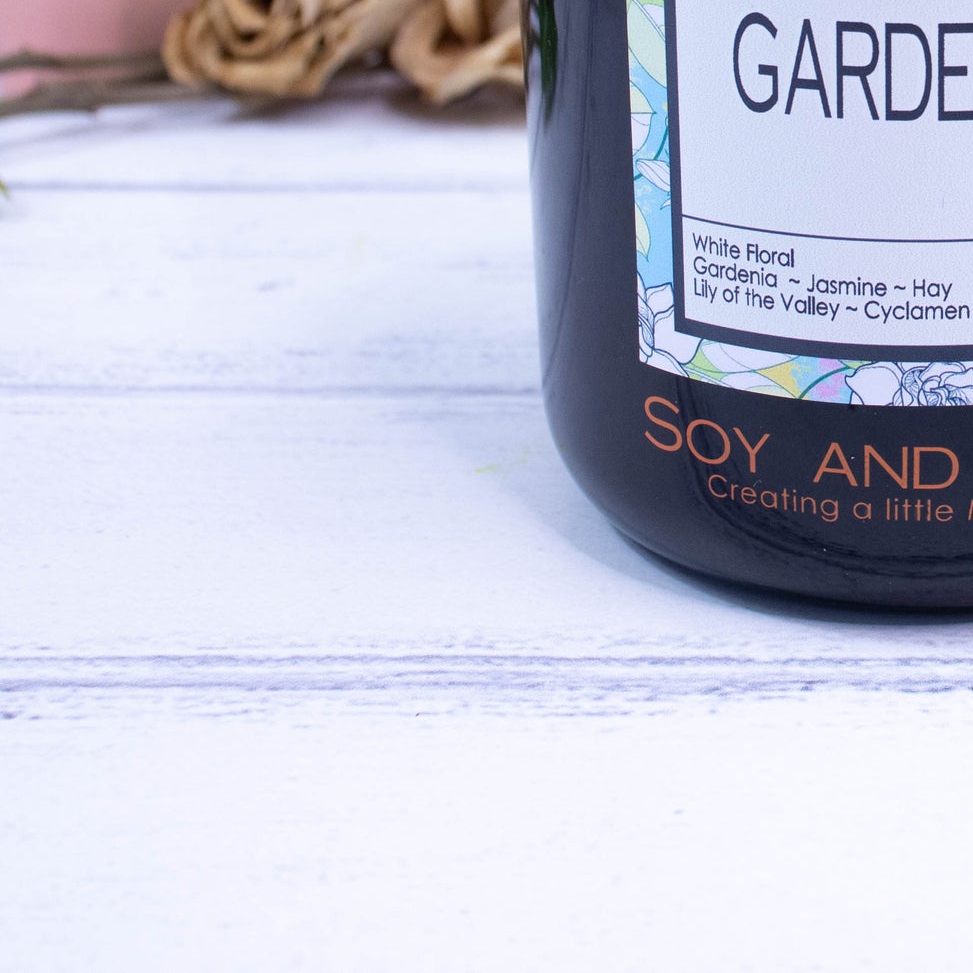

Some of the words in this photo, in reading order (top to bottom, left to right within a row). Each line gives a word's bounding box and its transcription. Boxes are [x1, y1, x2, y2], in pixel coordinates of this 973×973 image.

[692, 232, 741, 260] White
[746, 243, 795, 268] Floral
[693, 256, 778, 288] Gardenia
[806, 274, 888, 297] Jasmine
[912, 278, 953, 302] Hay
[693, 277, 718, 304] Lily
[722, 285, 741, 305] of
[744, 287, 775, 310] the
[780, 292, 841, 322] Valley
[863, 300, 971, 325] Cyclamen
[643, 394, 771, 474] SOY
[813, 441, 960, 490] AND
[707, 473, 840, 523] Creating
[852, 502, 873, 521] a
[885, 496, 955, 523] little
